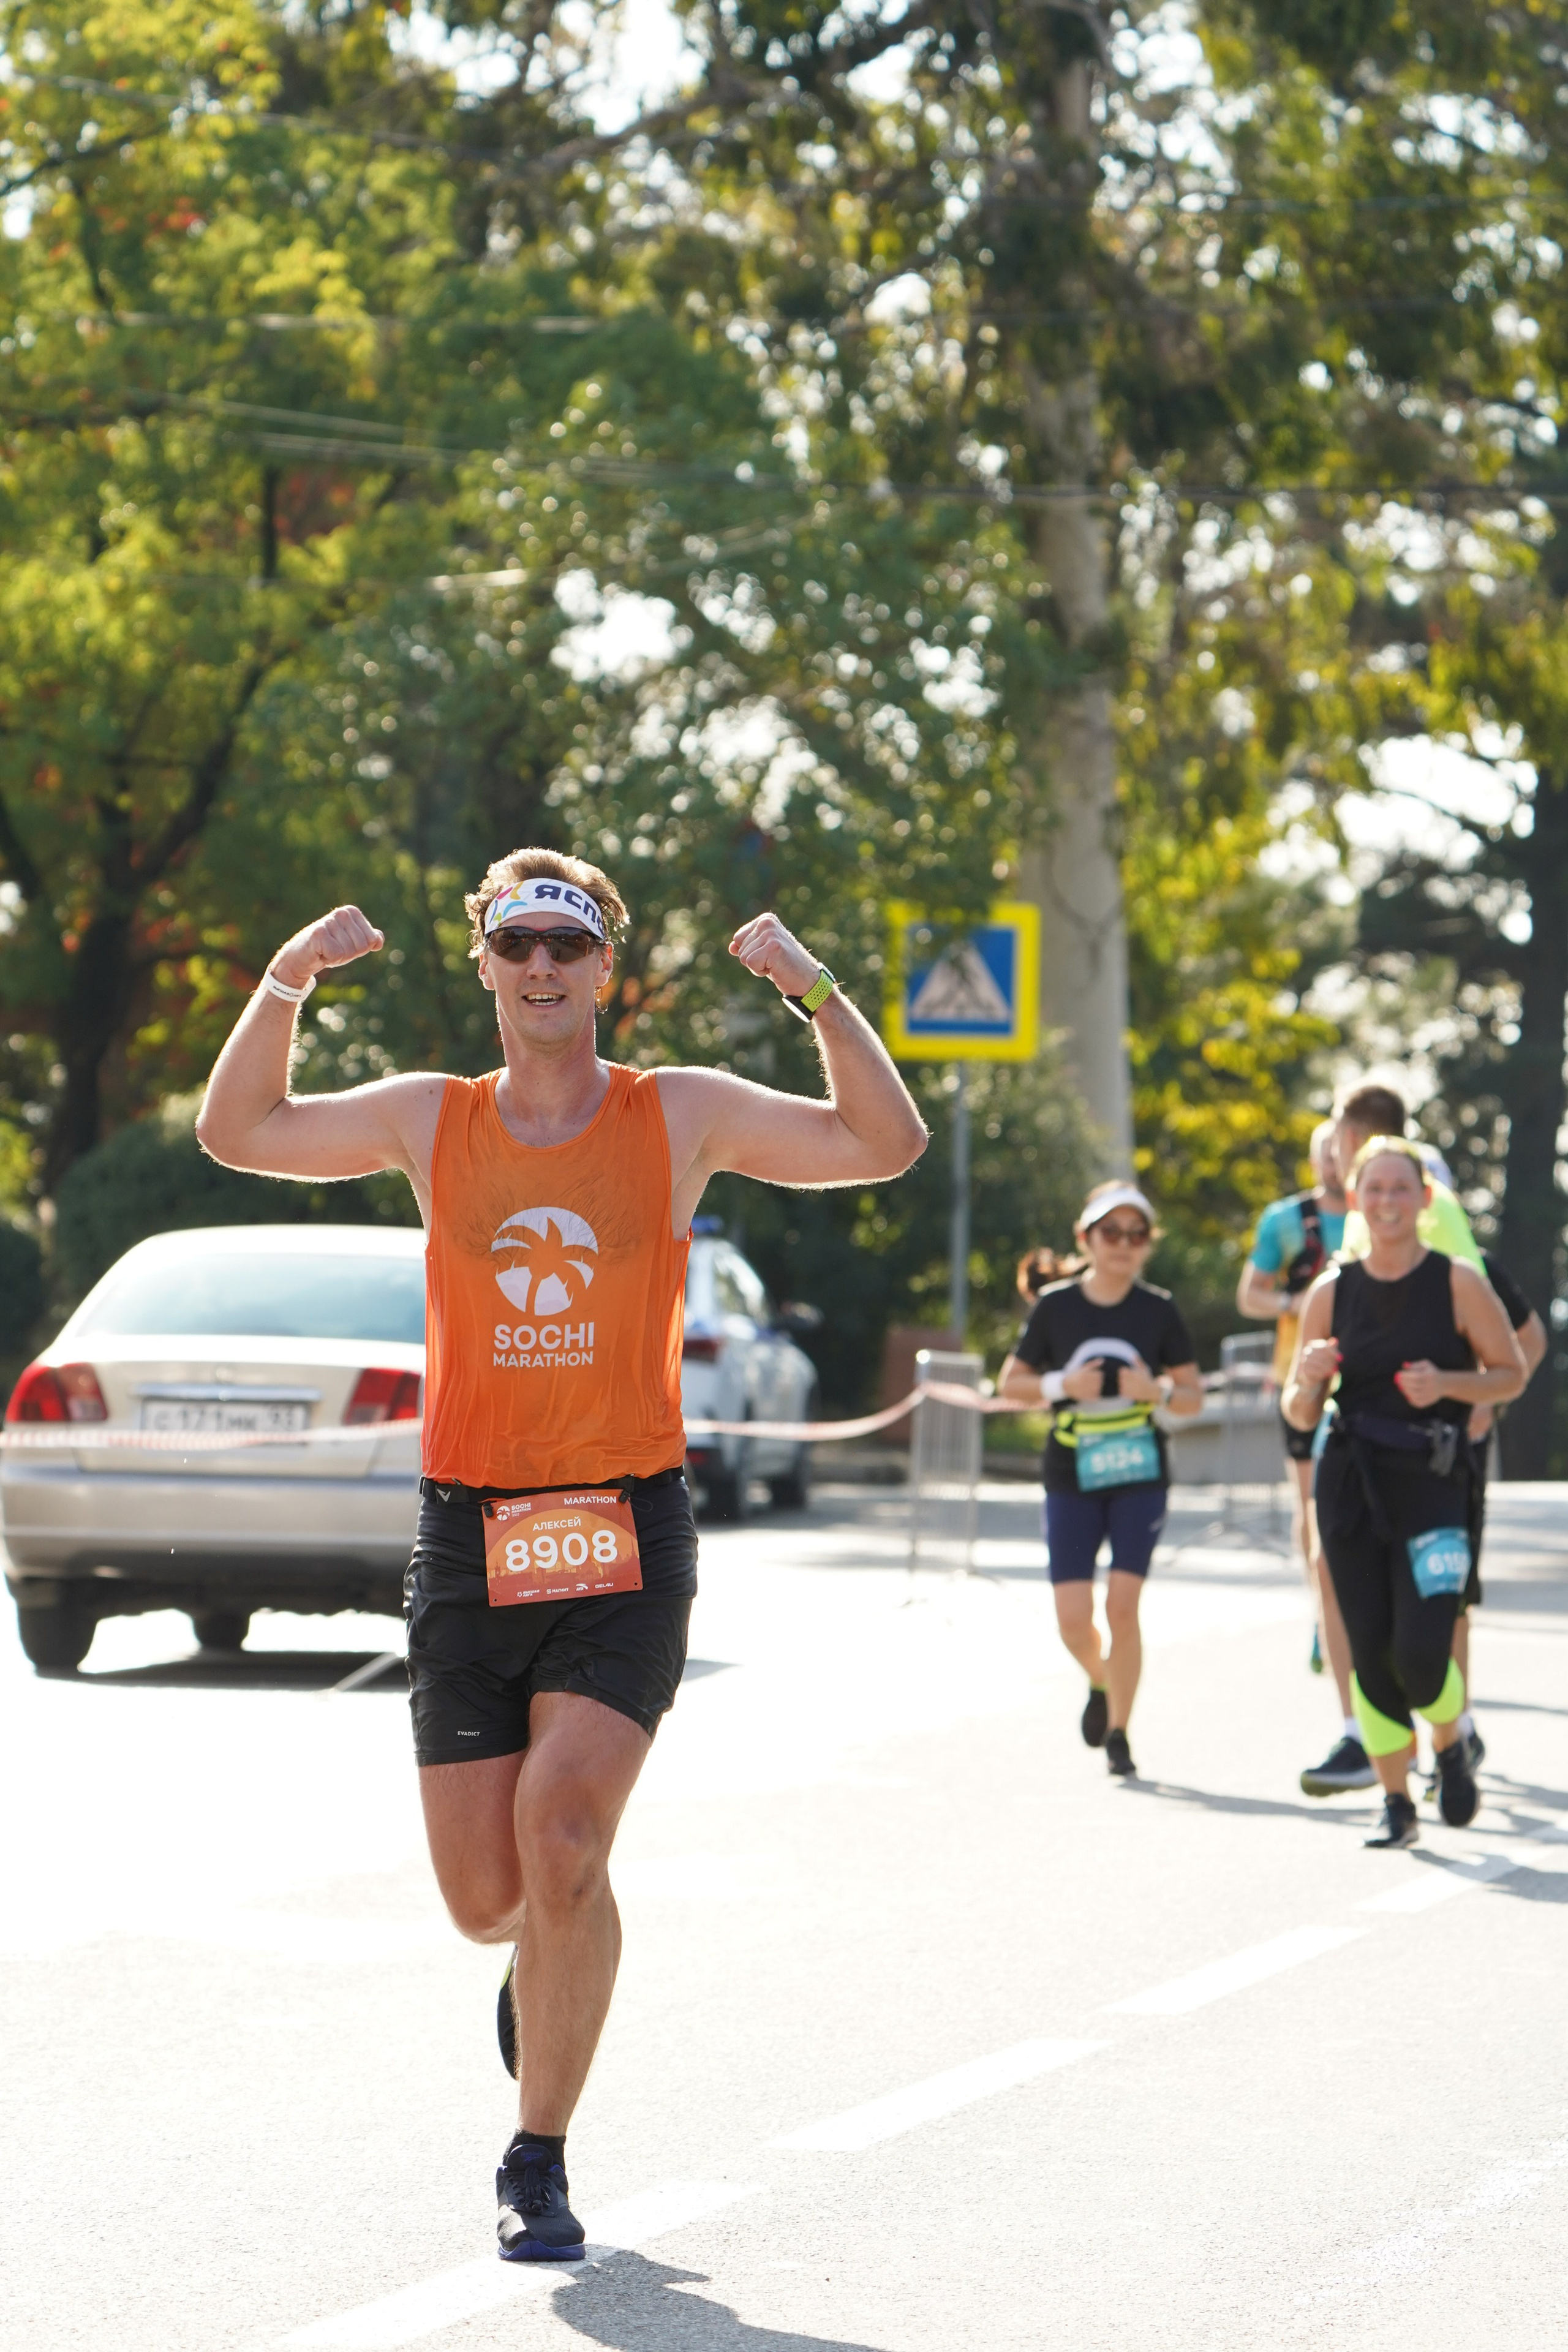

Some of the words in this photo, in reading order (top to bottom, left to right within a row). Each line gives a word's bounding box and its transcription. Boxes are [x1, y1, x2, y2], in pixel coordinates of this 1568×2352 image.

[494, 1322, 595, 1351] SOCHI
[493, 1351, 594, 1368] MARATHON
[564, 1496, 617, 1505] MARATHON
[533, 1517, 581, 1531] АЛЕКСЕЙ
[505, 1529, 618, 1572] 8908
